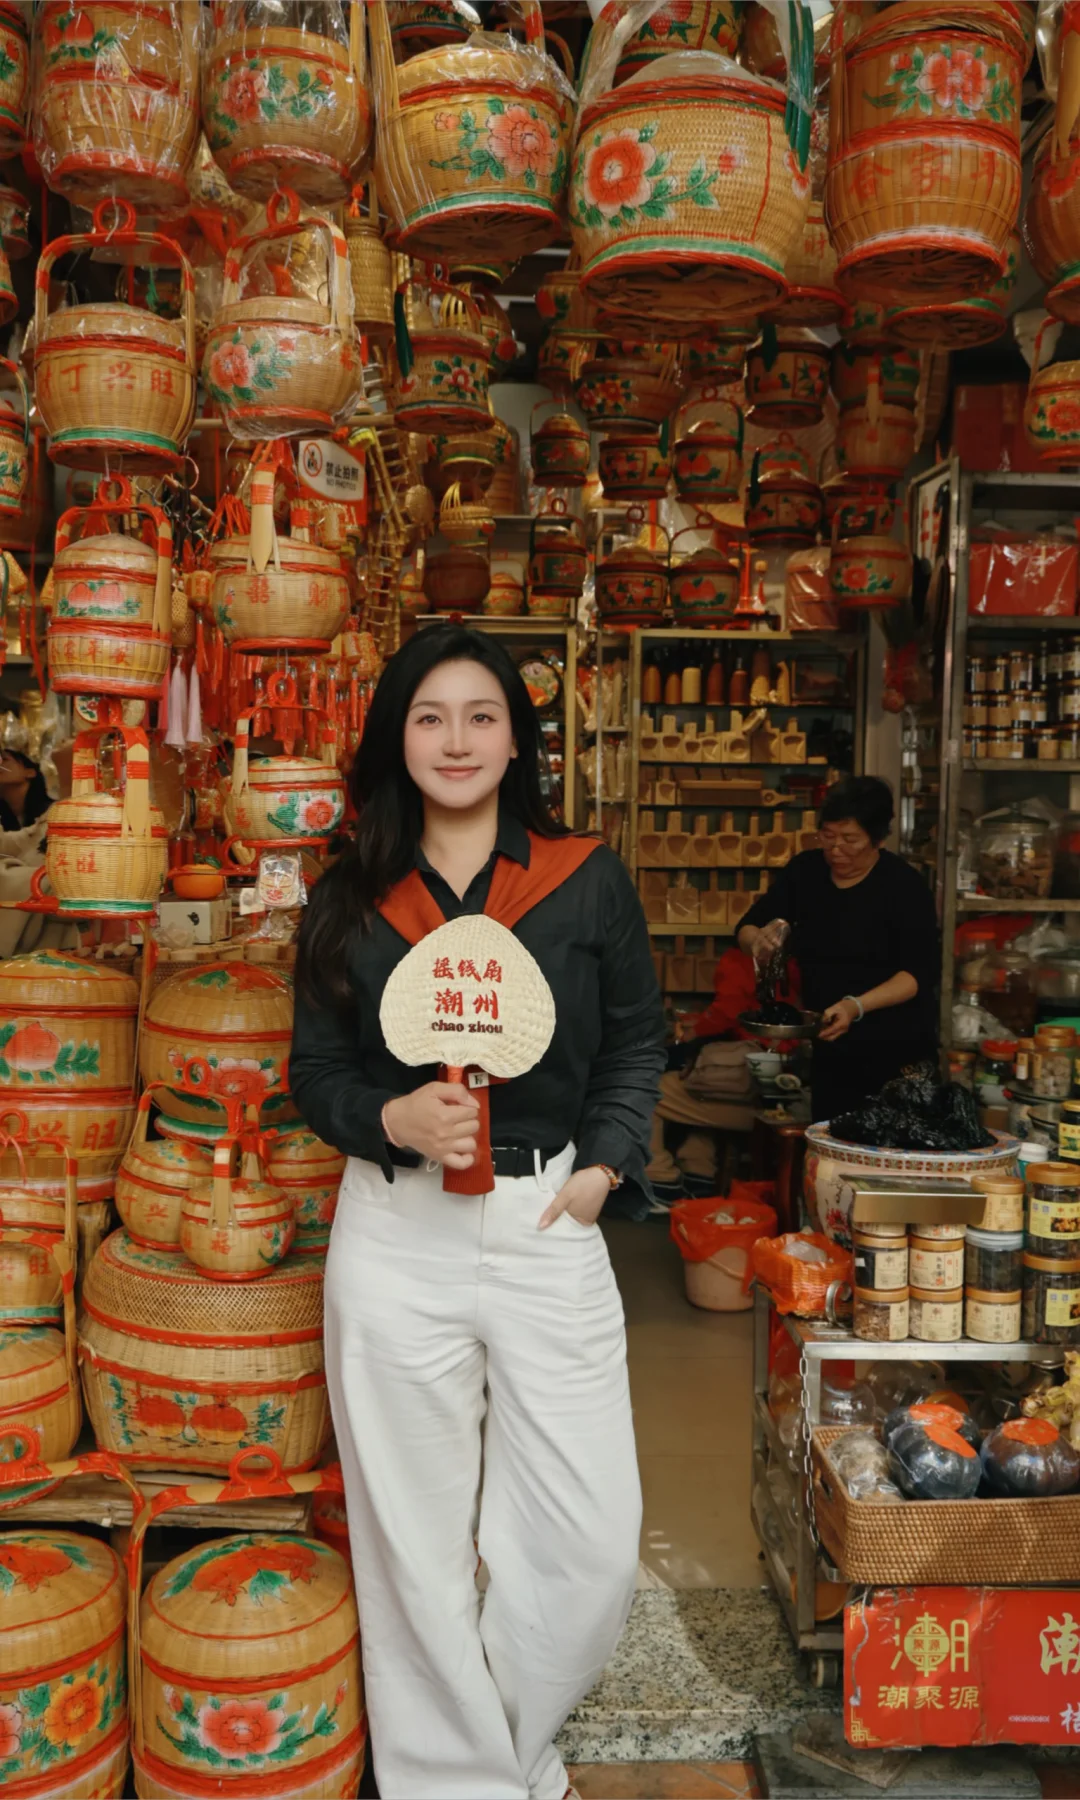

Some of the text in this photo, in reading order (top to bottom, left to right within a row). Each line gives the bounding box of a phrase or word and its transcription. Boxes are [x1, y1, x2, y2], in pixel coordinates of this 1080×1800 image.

[326, 462, 359, 481] 禁止拍照
[434, 988, 499, 1020] 潮州
[431, 1019, 503, 1034] chao zhou
[877, 1684, 980, 1710] 潮聚源
